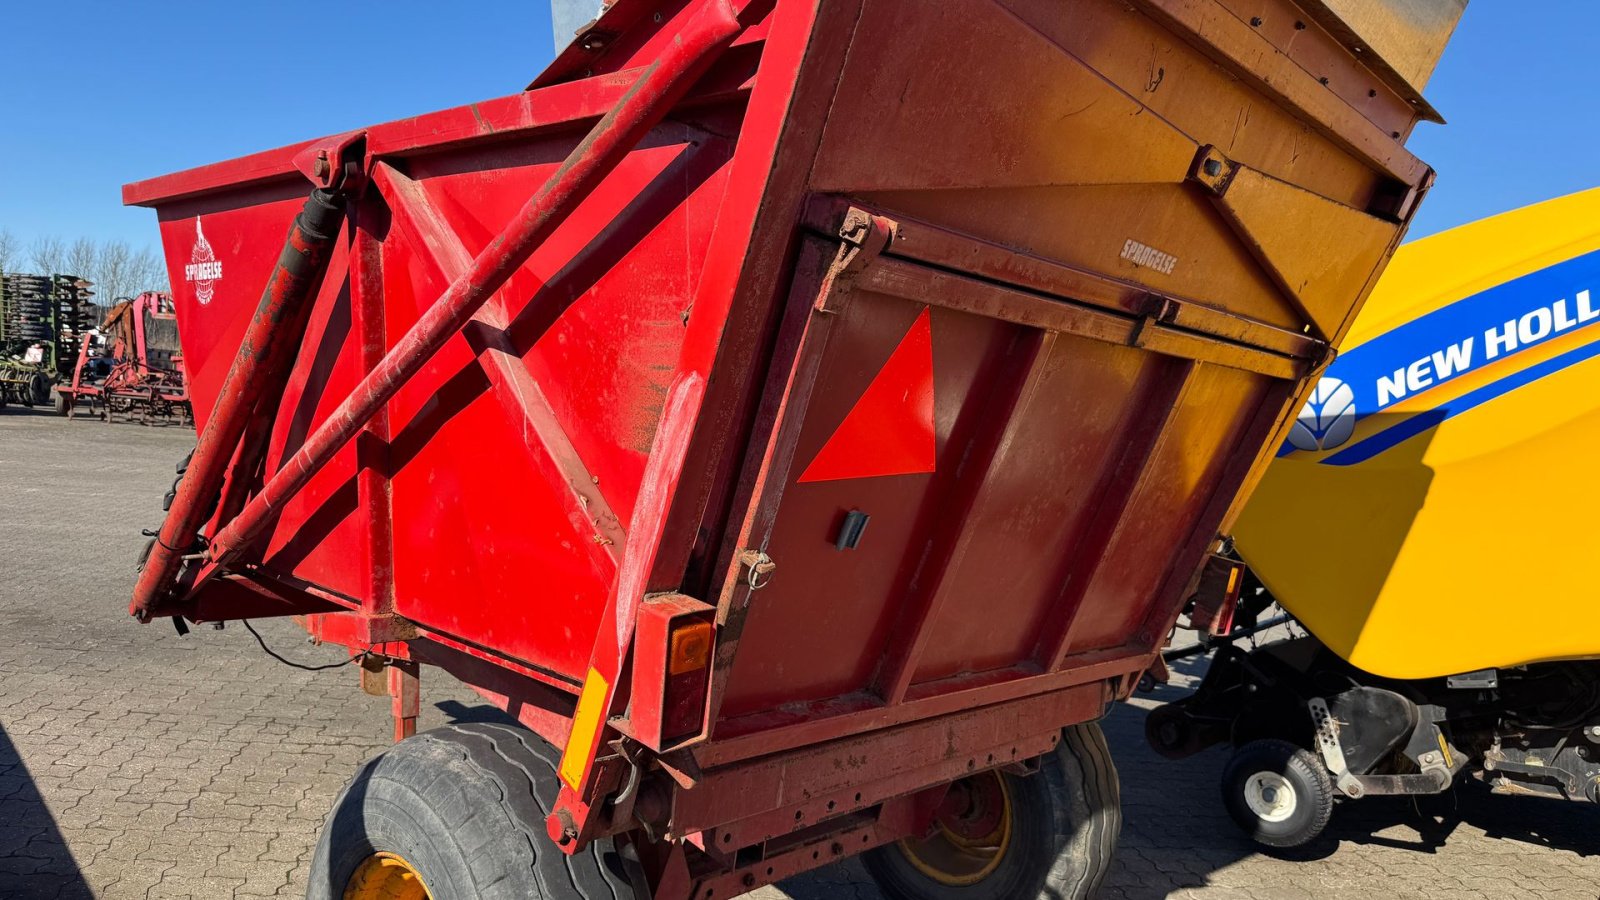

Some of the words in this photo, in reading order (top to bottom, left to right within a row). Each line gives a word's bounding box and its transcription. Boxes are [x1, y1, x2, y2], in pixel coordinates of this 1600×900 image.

[185, 261, 222, 281] SPRAGELSE
[1120, 239, 1178, 275] SPRAGELSE
[1377, 336, 1474, 407] NEW
[1484, 289, 1600, 360] HOLL
